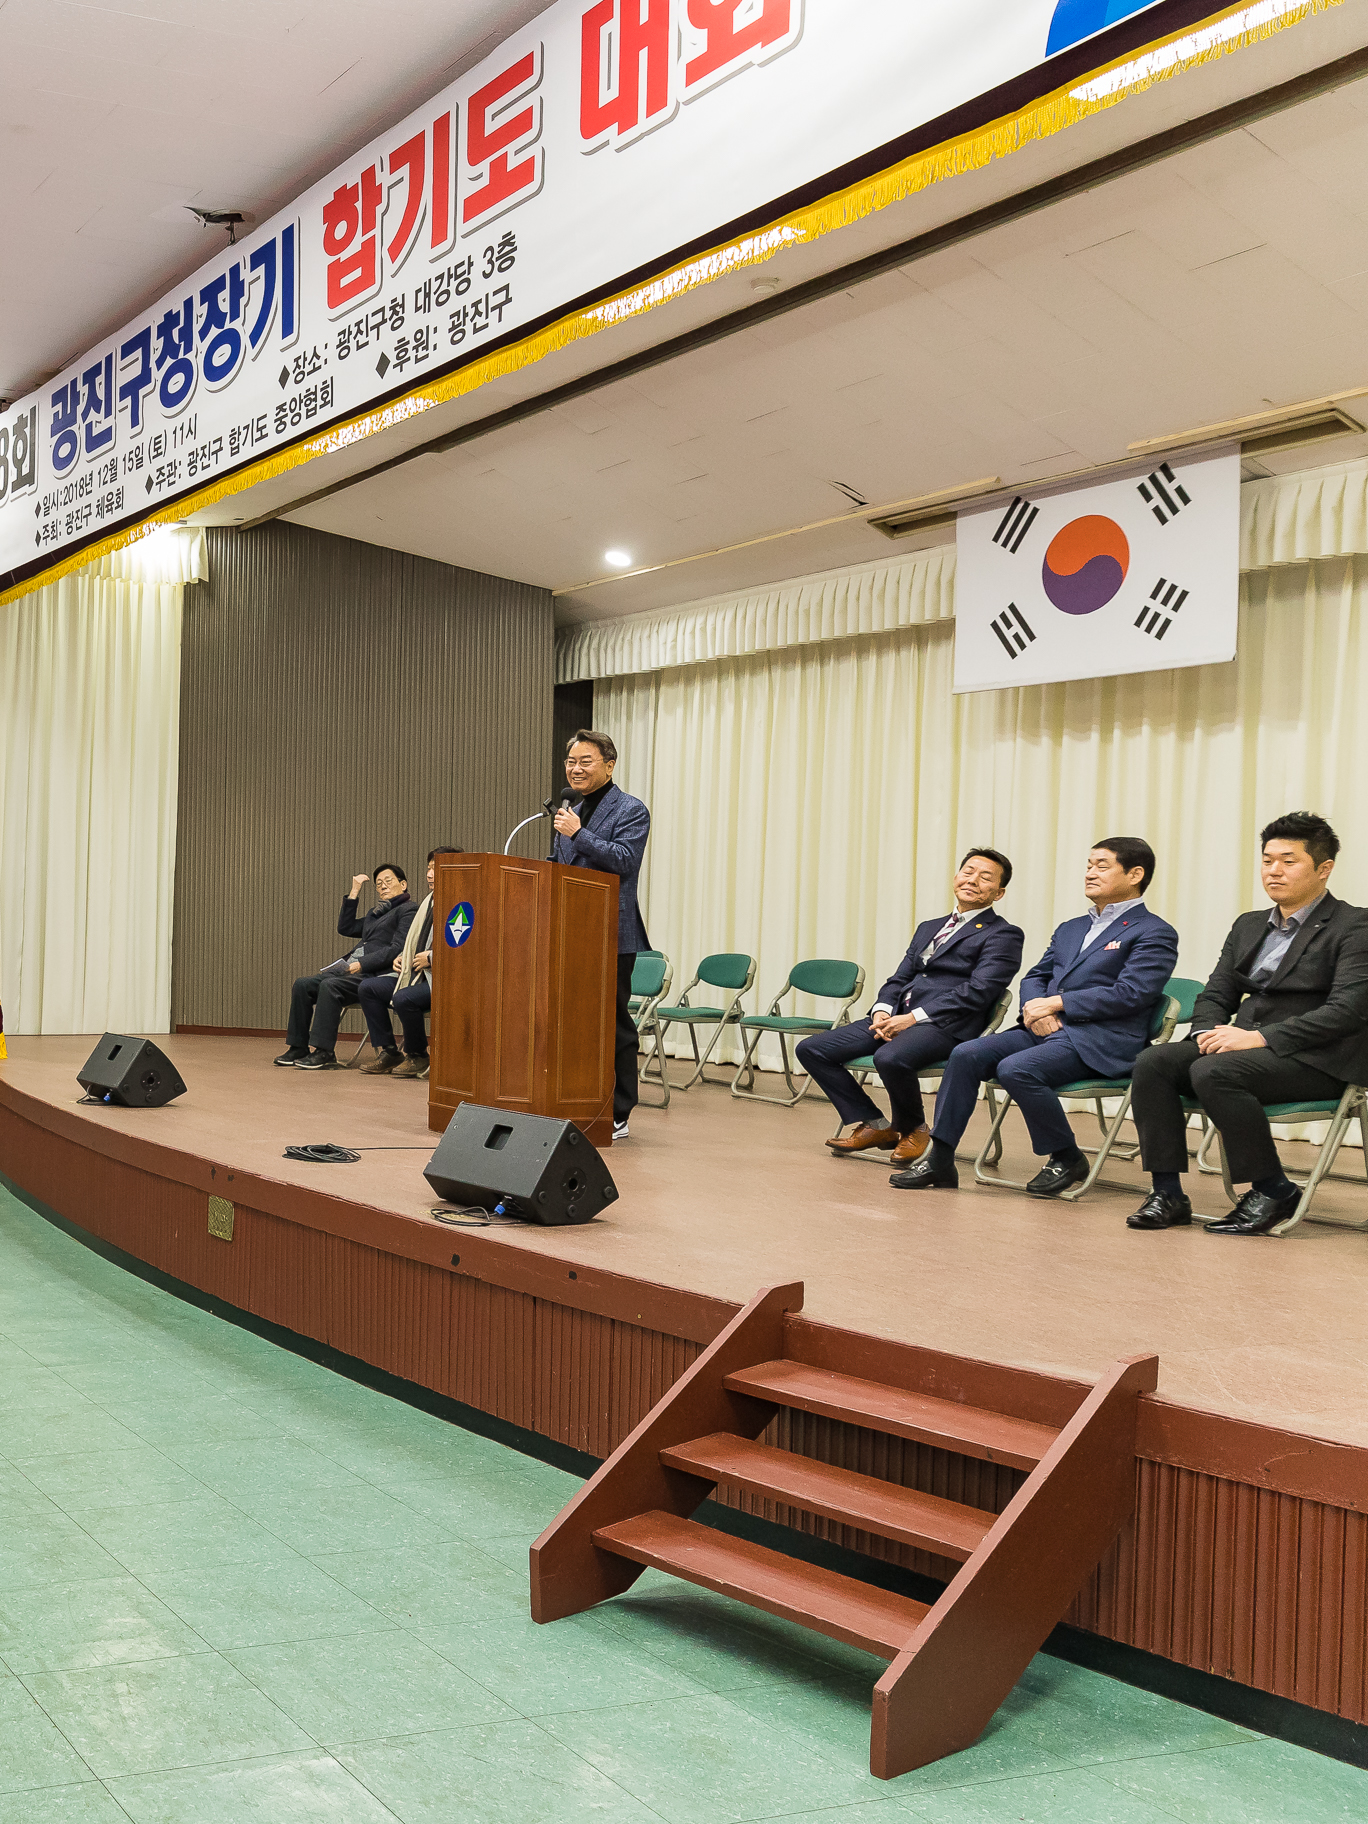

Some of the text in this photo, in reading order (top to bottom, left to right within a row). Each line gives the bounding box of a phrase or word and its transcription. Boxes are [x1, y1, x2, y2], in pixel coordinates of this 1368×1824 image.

[50, 223, 295, 471] 광진구청장기
[322, 50, 535, 311] 합기도
[292, 230, 518, 385] 장소: 광진구청 대강당 3층
[393, 282, 513, 373] 후원: 광진구
[97, 457, 118, 488] 12월
[122, 442, 144, 475] 15일
[148, 429, 167, 464] (토)
[172, 413, 197, 448] 11시
[155, 376, 333, 492] 주관: 광진구 합기도 중앙협회
[42, 485, 125, 546] 주최: 광진구 체육회
